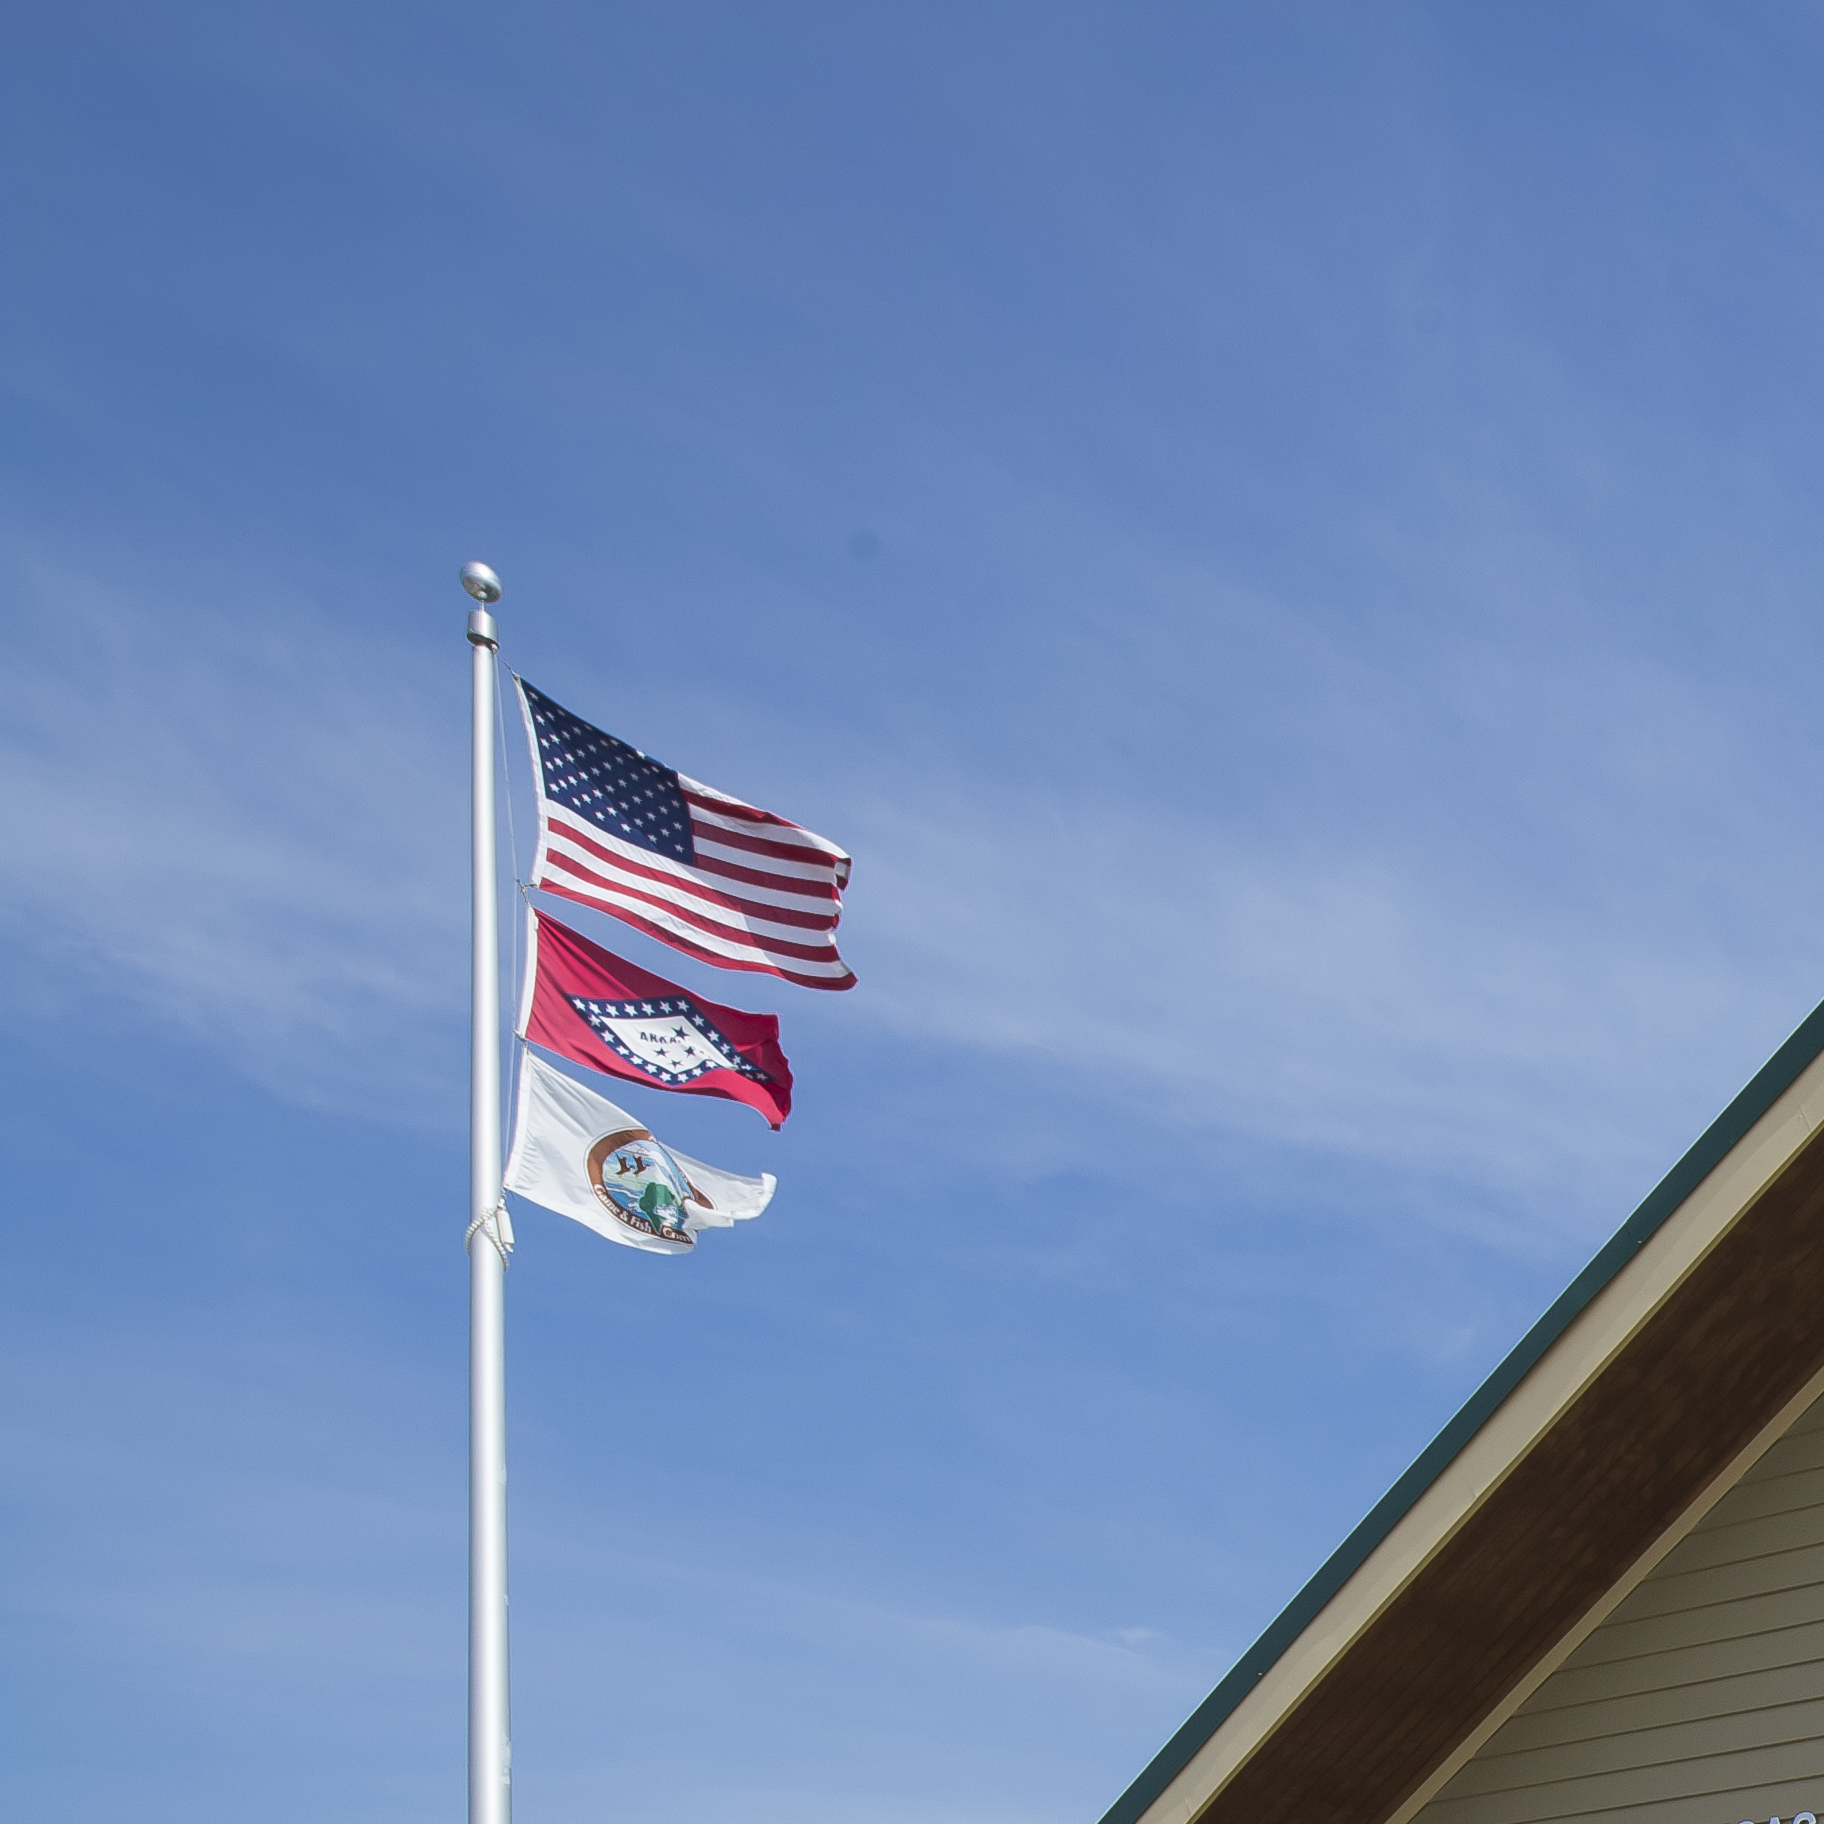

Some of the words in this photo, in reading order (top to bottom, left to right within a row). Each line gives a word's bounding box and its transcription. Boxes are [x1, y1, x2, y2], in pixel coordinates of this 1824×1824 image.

[594, 1184, 620, 1215] Game
[619, 1211, 629, 1222] &
[630, 1217, 652, 1234] Fish
